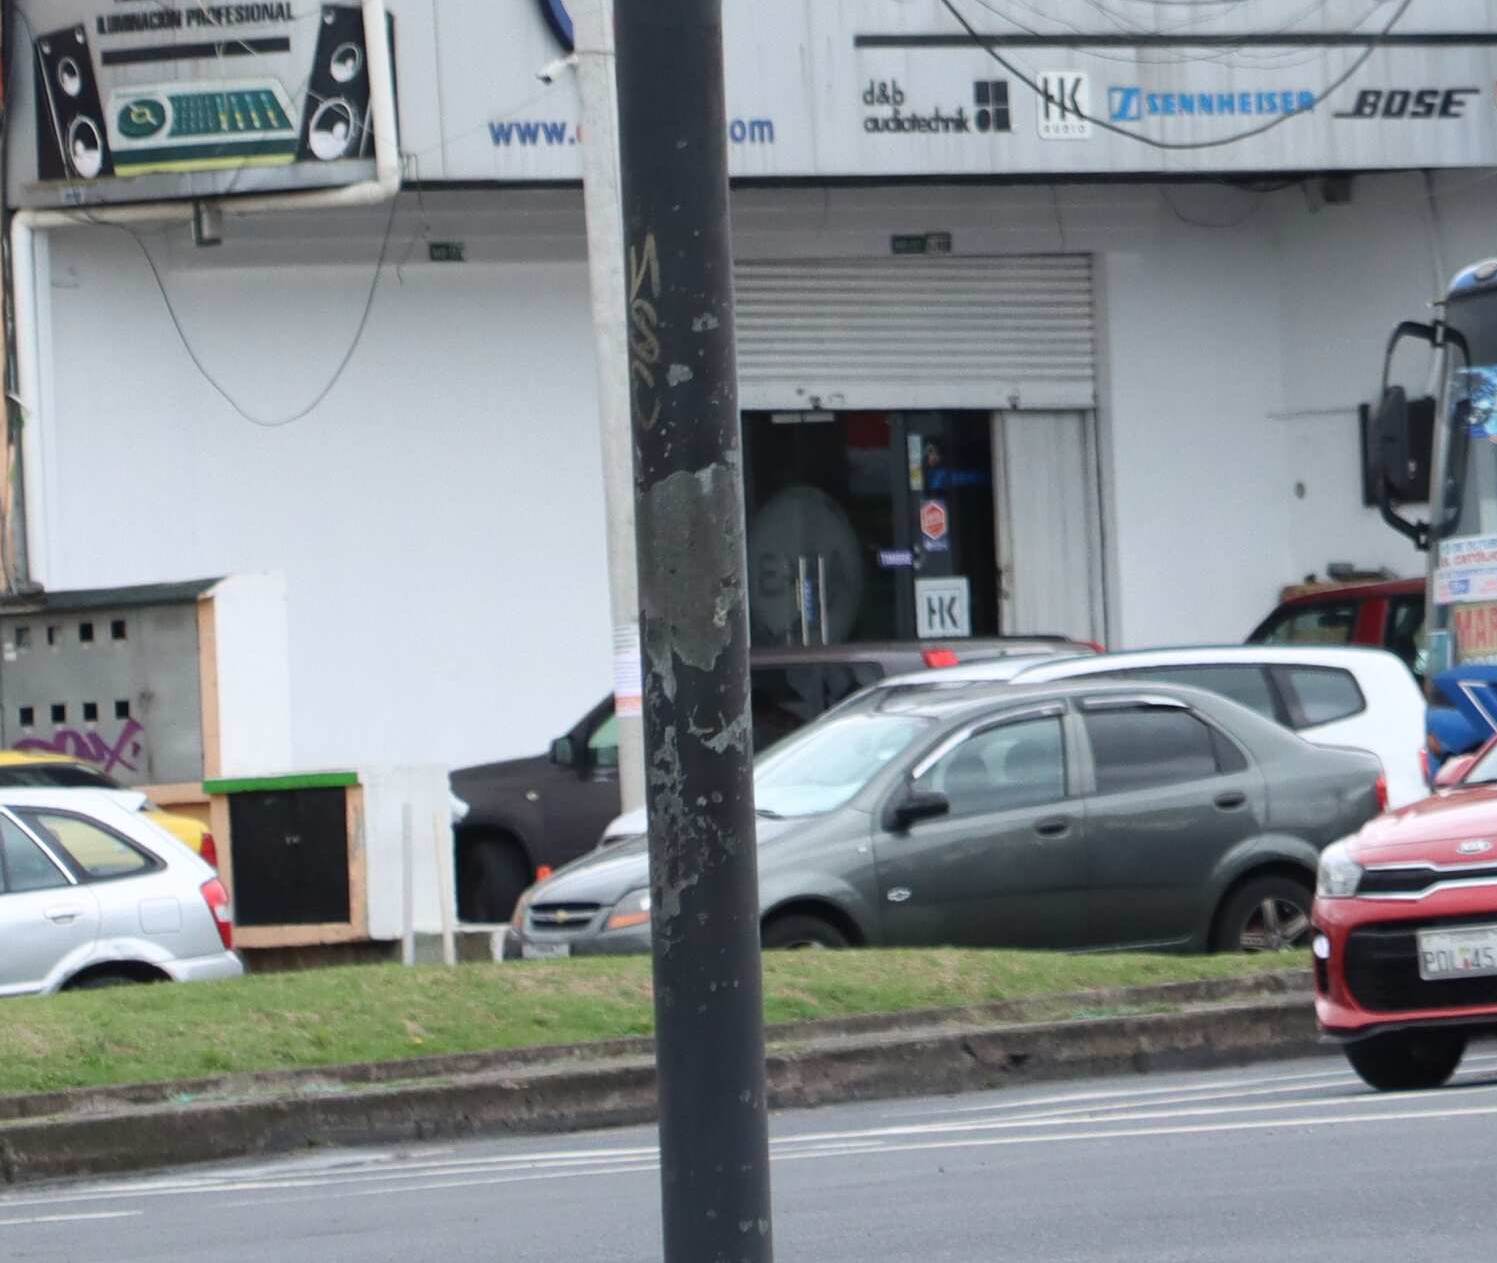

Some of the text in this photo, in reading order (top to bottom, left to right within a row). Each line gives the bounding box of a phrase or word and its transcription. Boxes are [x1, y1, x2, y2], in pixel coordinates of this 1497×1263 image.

[186, 1, 295, 28] PROFESIONAL
[862, 78, 905, 106] d&b
[1041, 76, 1083, 120] HK
[1146, 89, 1315, 115] SENNHEISER
[1332, 88, 1481, 120] BOSE
[925, 595, 961, 630] HK
